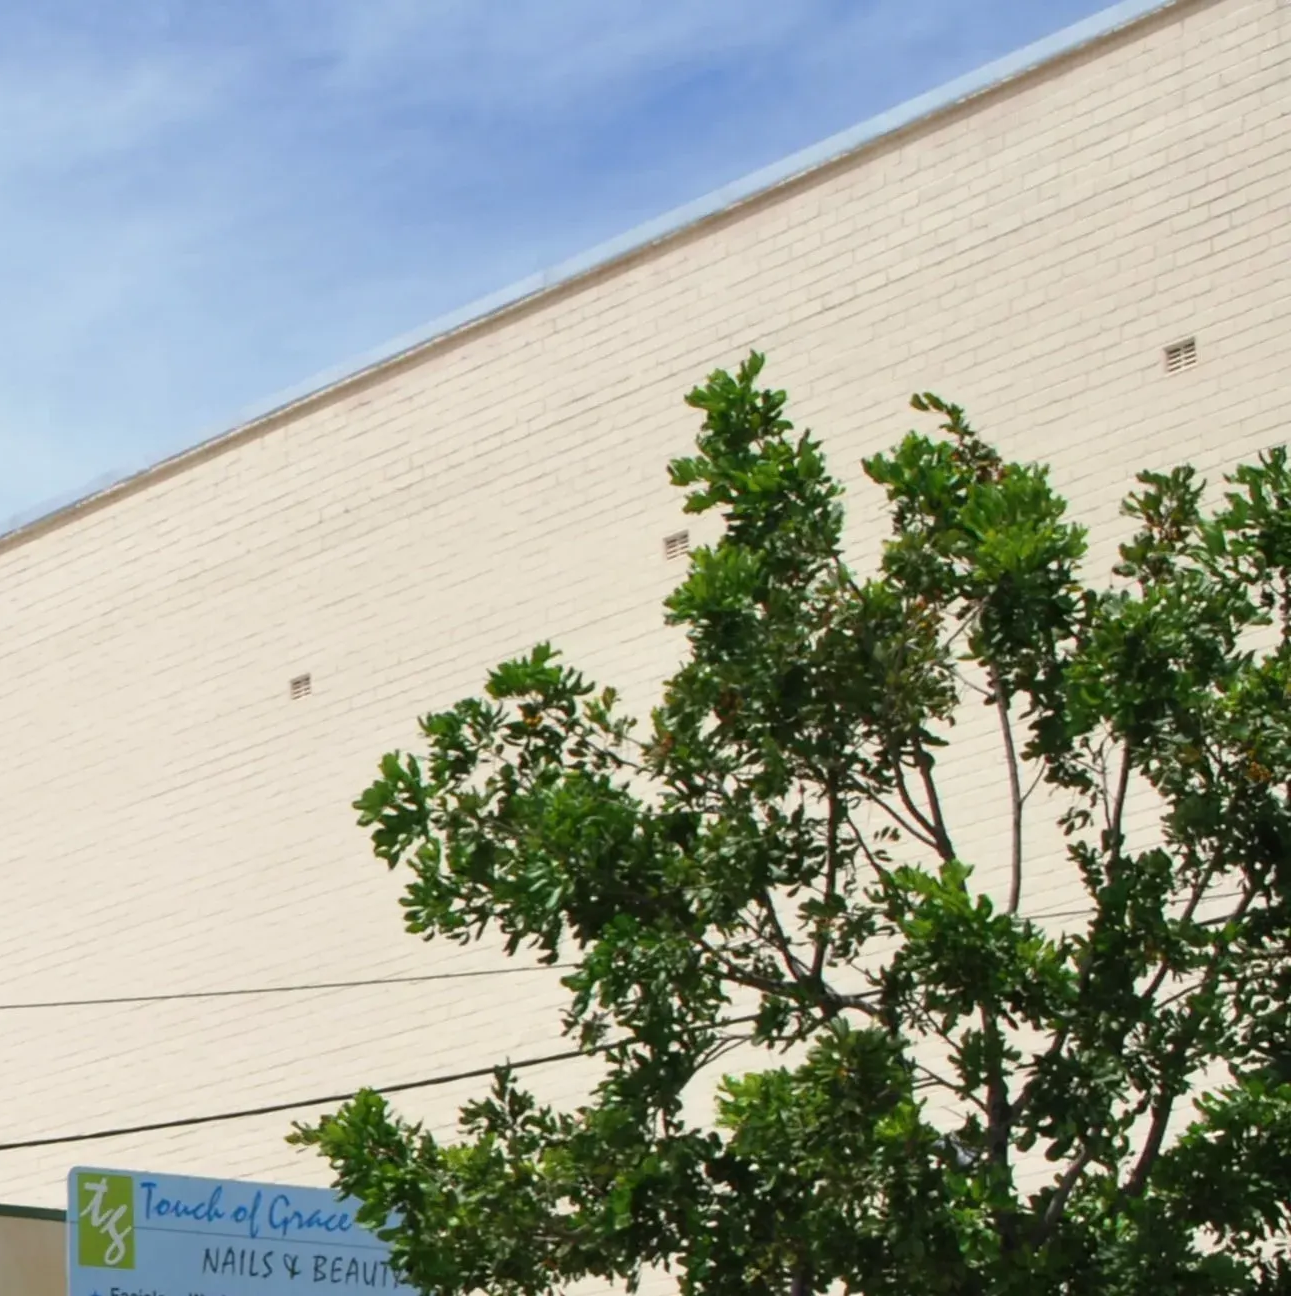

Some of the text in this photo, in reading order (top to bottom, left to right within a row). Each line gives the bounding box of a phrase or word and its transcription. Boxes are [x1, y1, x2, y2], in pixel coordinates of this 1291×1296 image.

[140, 1182, 353, 1239] Touch of Grace
[202, 1247, 274, 1279] NAILS
[284, 1254, 301, 1279] &
